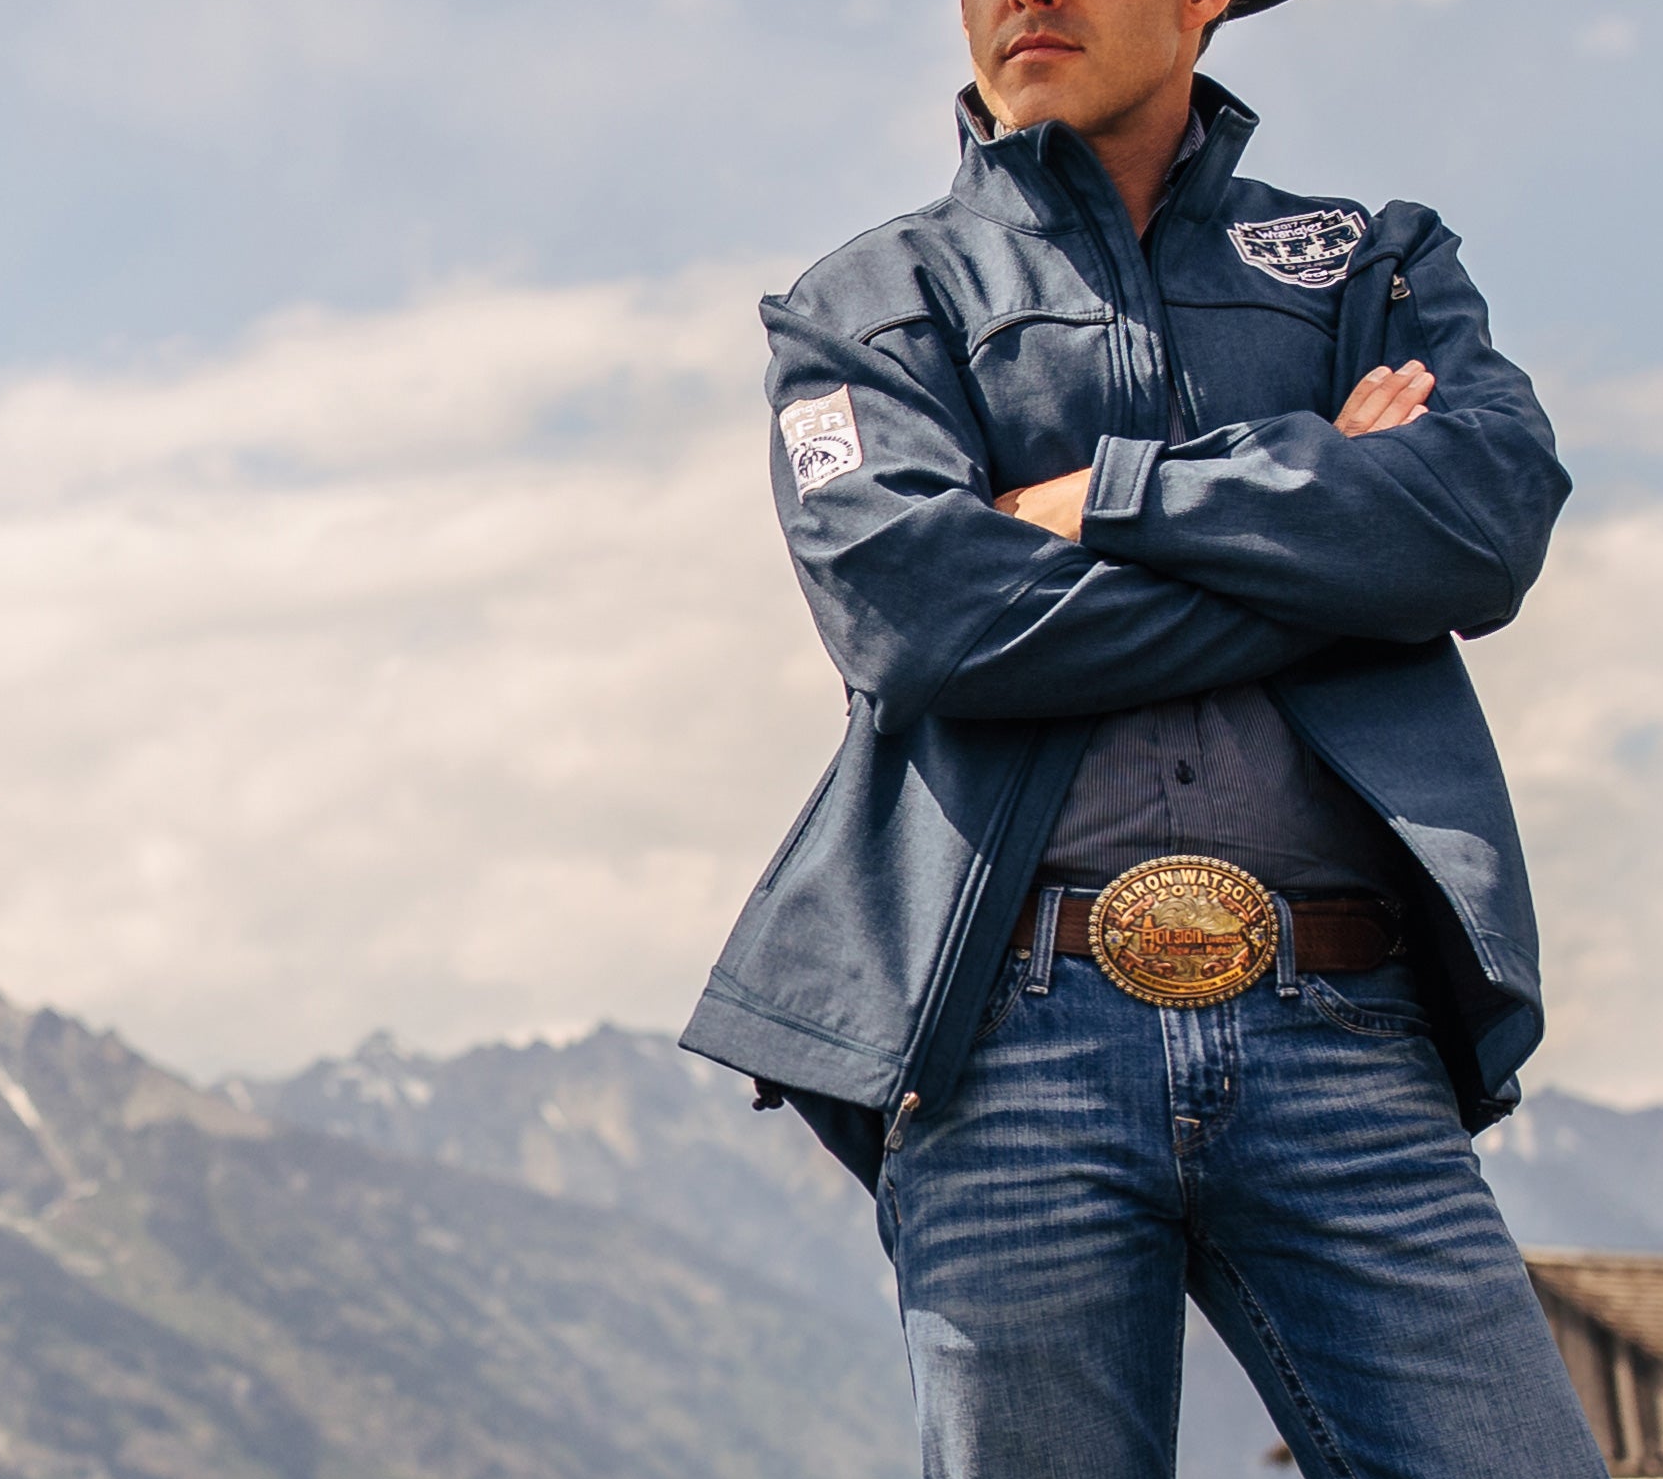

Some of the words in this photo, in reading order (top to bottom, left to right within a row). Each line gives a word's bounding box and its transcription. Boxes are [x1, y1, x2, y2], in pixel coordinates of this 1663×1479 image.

[1255, 222, 1323, 240] Wrangler
[1272, 221, 1298, 231] 2017
[1242, 225, 1358, 258] NFR
[1299, 248, 1344, 262] VEGAS
[1111, 870, 1174, 914] AARON
[1180, 868, 1256, 911] WATSON
[1154, 884, 1219, 902] 2017
